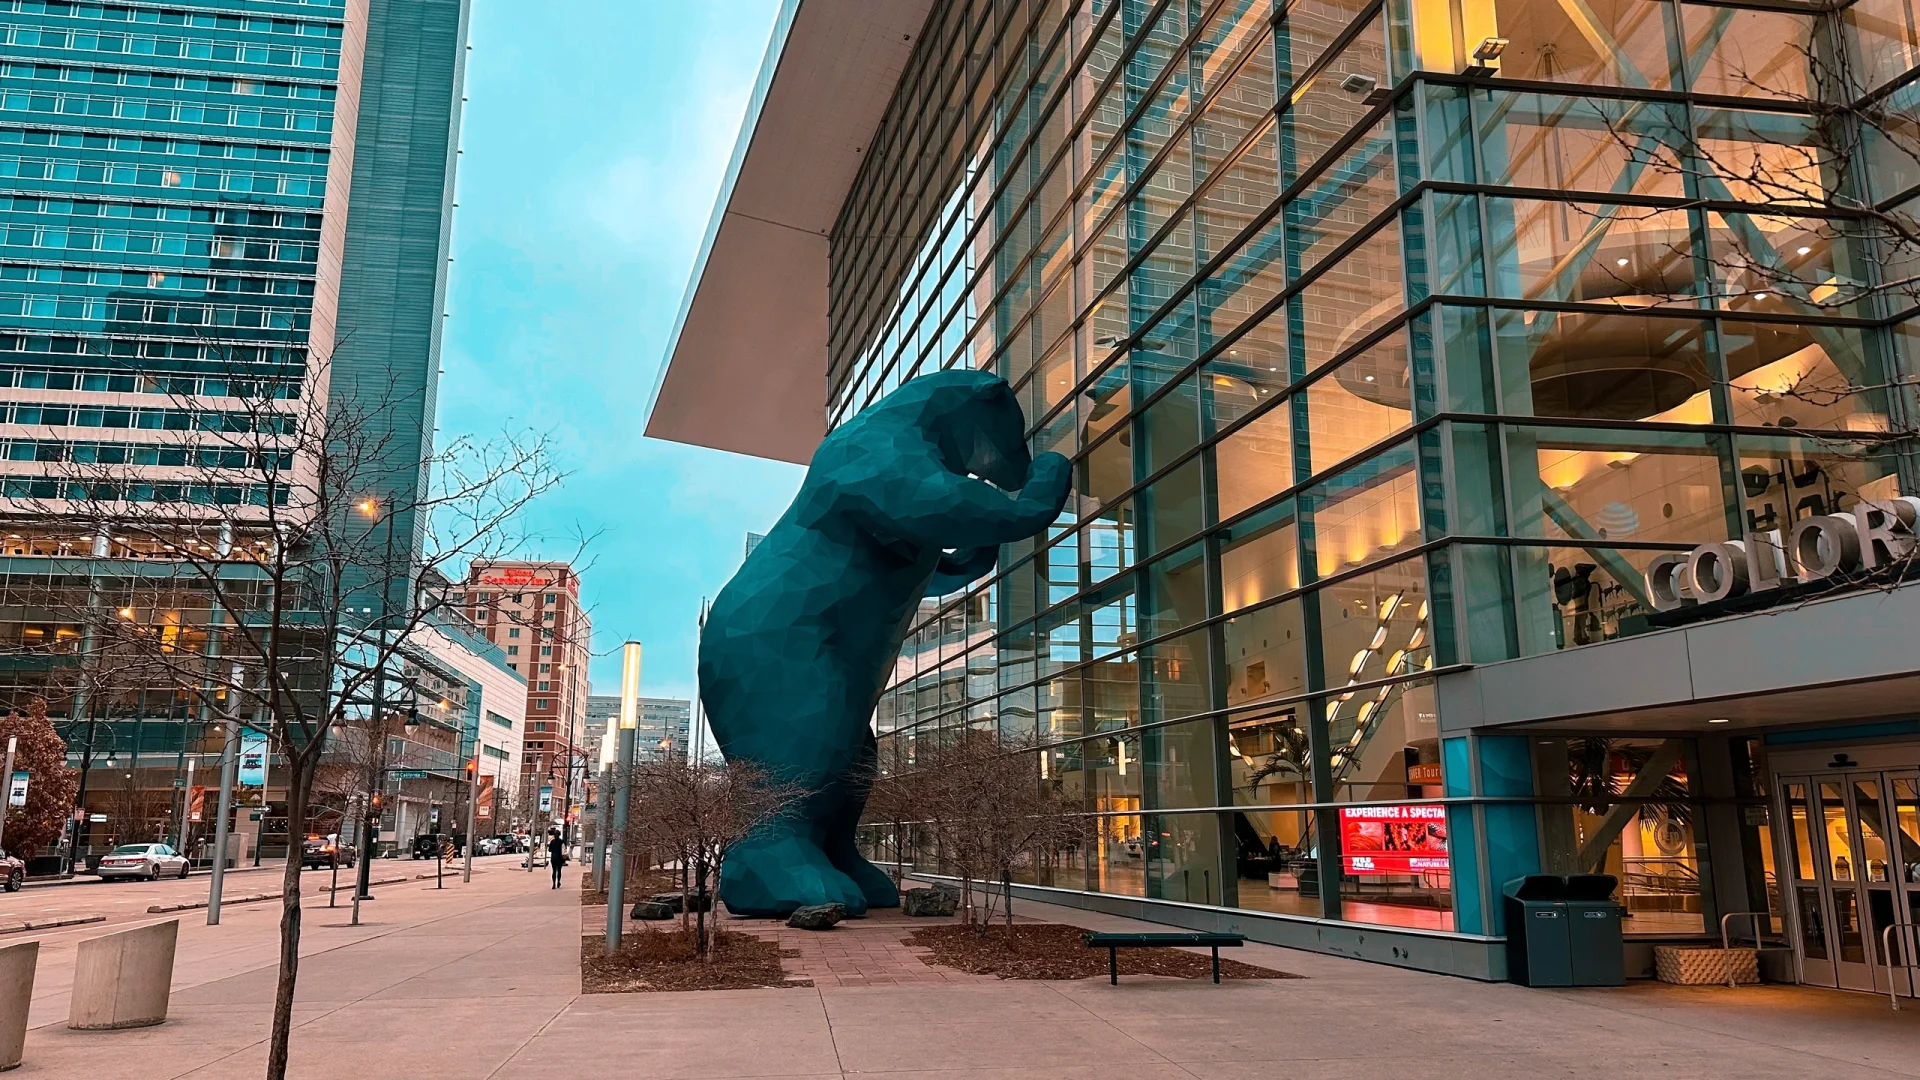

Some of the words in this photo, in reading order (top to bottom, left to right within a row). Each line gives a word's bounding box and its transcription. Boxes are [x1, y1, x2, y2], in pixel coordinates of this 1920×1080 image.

[1644, 496, 1918, 613] COLOR
[504, 568, 534, 578] Hilton
[483, 575, 527, 585] Garden
[531, 576, 551, 585] Inn
[1345, 807, 1399, 818] EXPERIENCE
[1401, 807, 1408, 818] A
